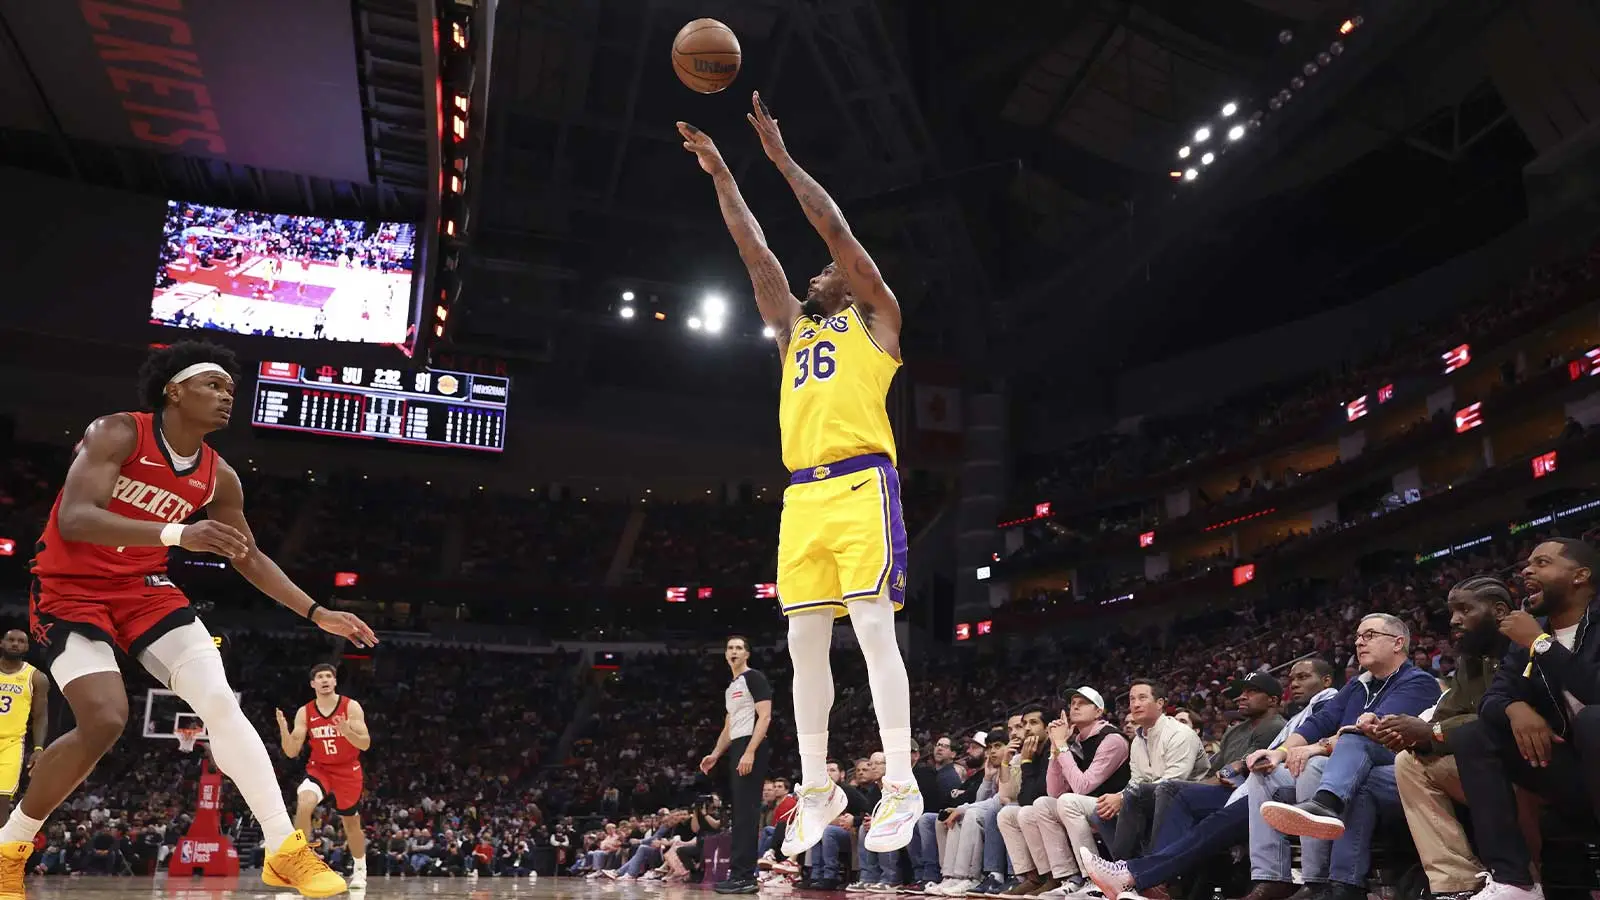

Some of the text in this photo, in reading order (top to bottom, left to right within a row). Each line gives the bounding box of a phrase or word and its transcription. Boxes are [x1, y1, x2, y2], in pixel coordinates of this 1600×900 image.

[83, 0, 227, 153] CKETS
[794, 340, 836, 391] 36
[112, 475, 194, 524] ROCKETS
[321, 739, 337, 755] 15
[193, 851, 210, 863] Pass
[194, 840, 220, 853] League
